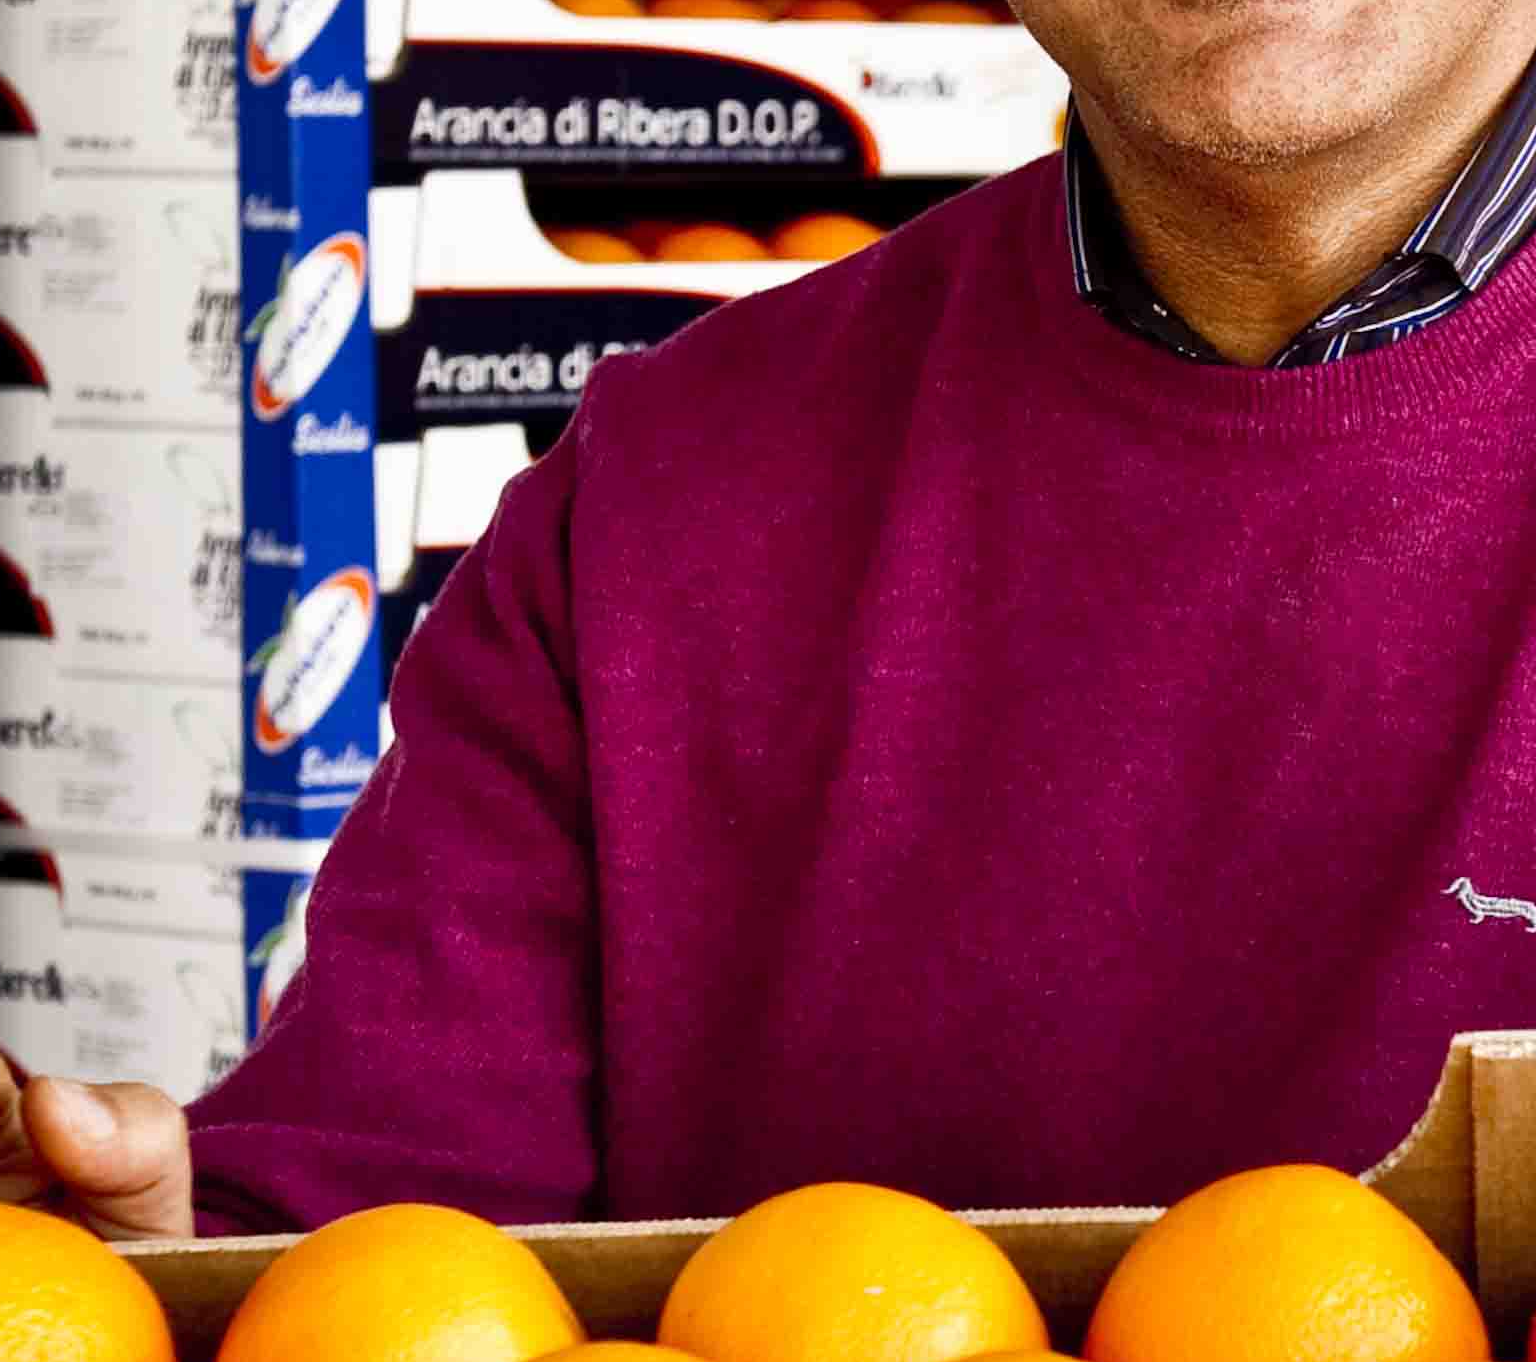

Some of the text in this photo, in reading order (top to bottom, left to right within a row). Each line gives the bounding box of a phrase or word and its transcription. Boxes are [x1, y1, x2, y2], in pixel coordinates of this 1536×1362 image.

[411, 98, 547, 145] Arancia
[554, 100, 589, 145] di
[598, 98, 710, 147] Ribera
